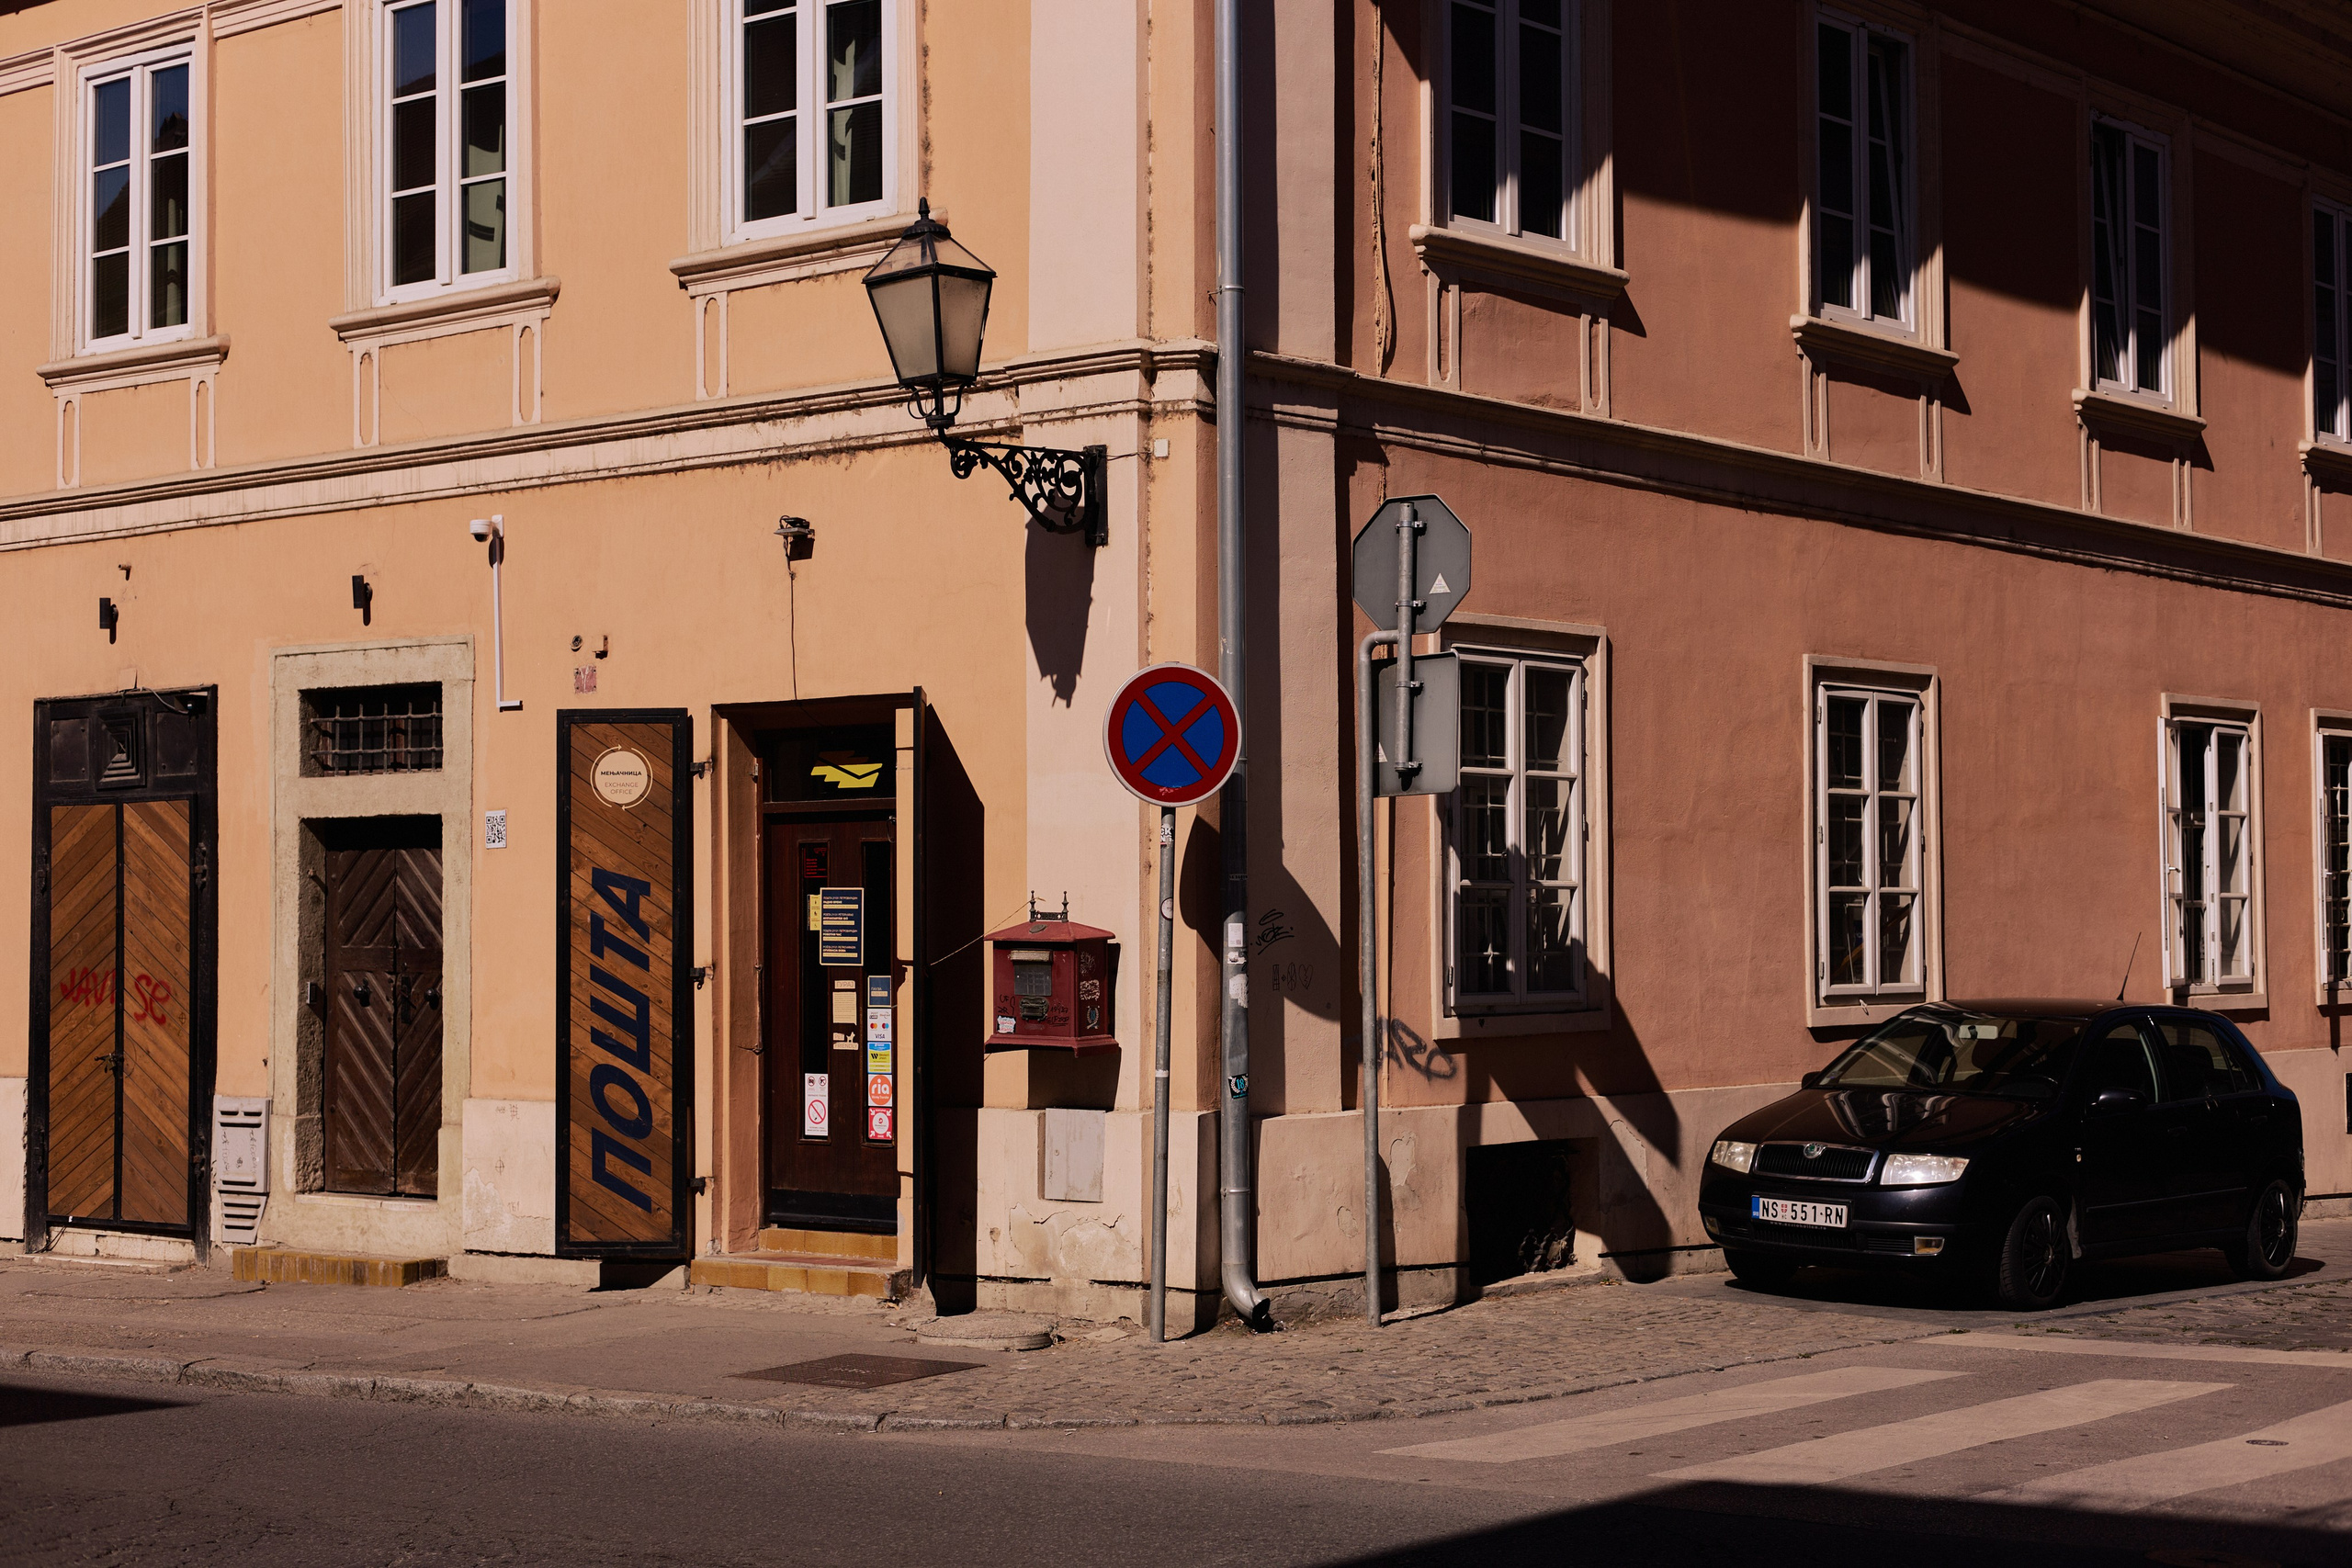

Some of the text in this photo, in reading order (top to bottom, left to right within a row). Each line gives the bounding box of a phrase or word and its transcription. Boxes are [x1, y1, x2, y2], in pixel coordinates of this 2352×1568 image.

[590, 866, 652, 1213] ПОШТА
[871, 1078, 889, 1094] ria
[1762, 1200, 1778, 1218] NS
